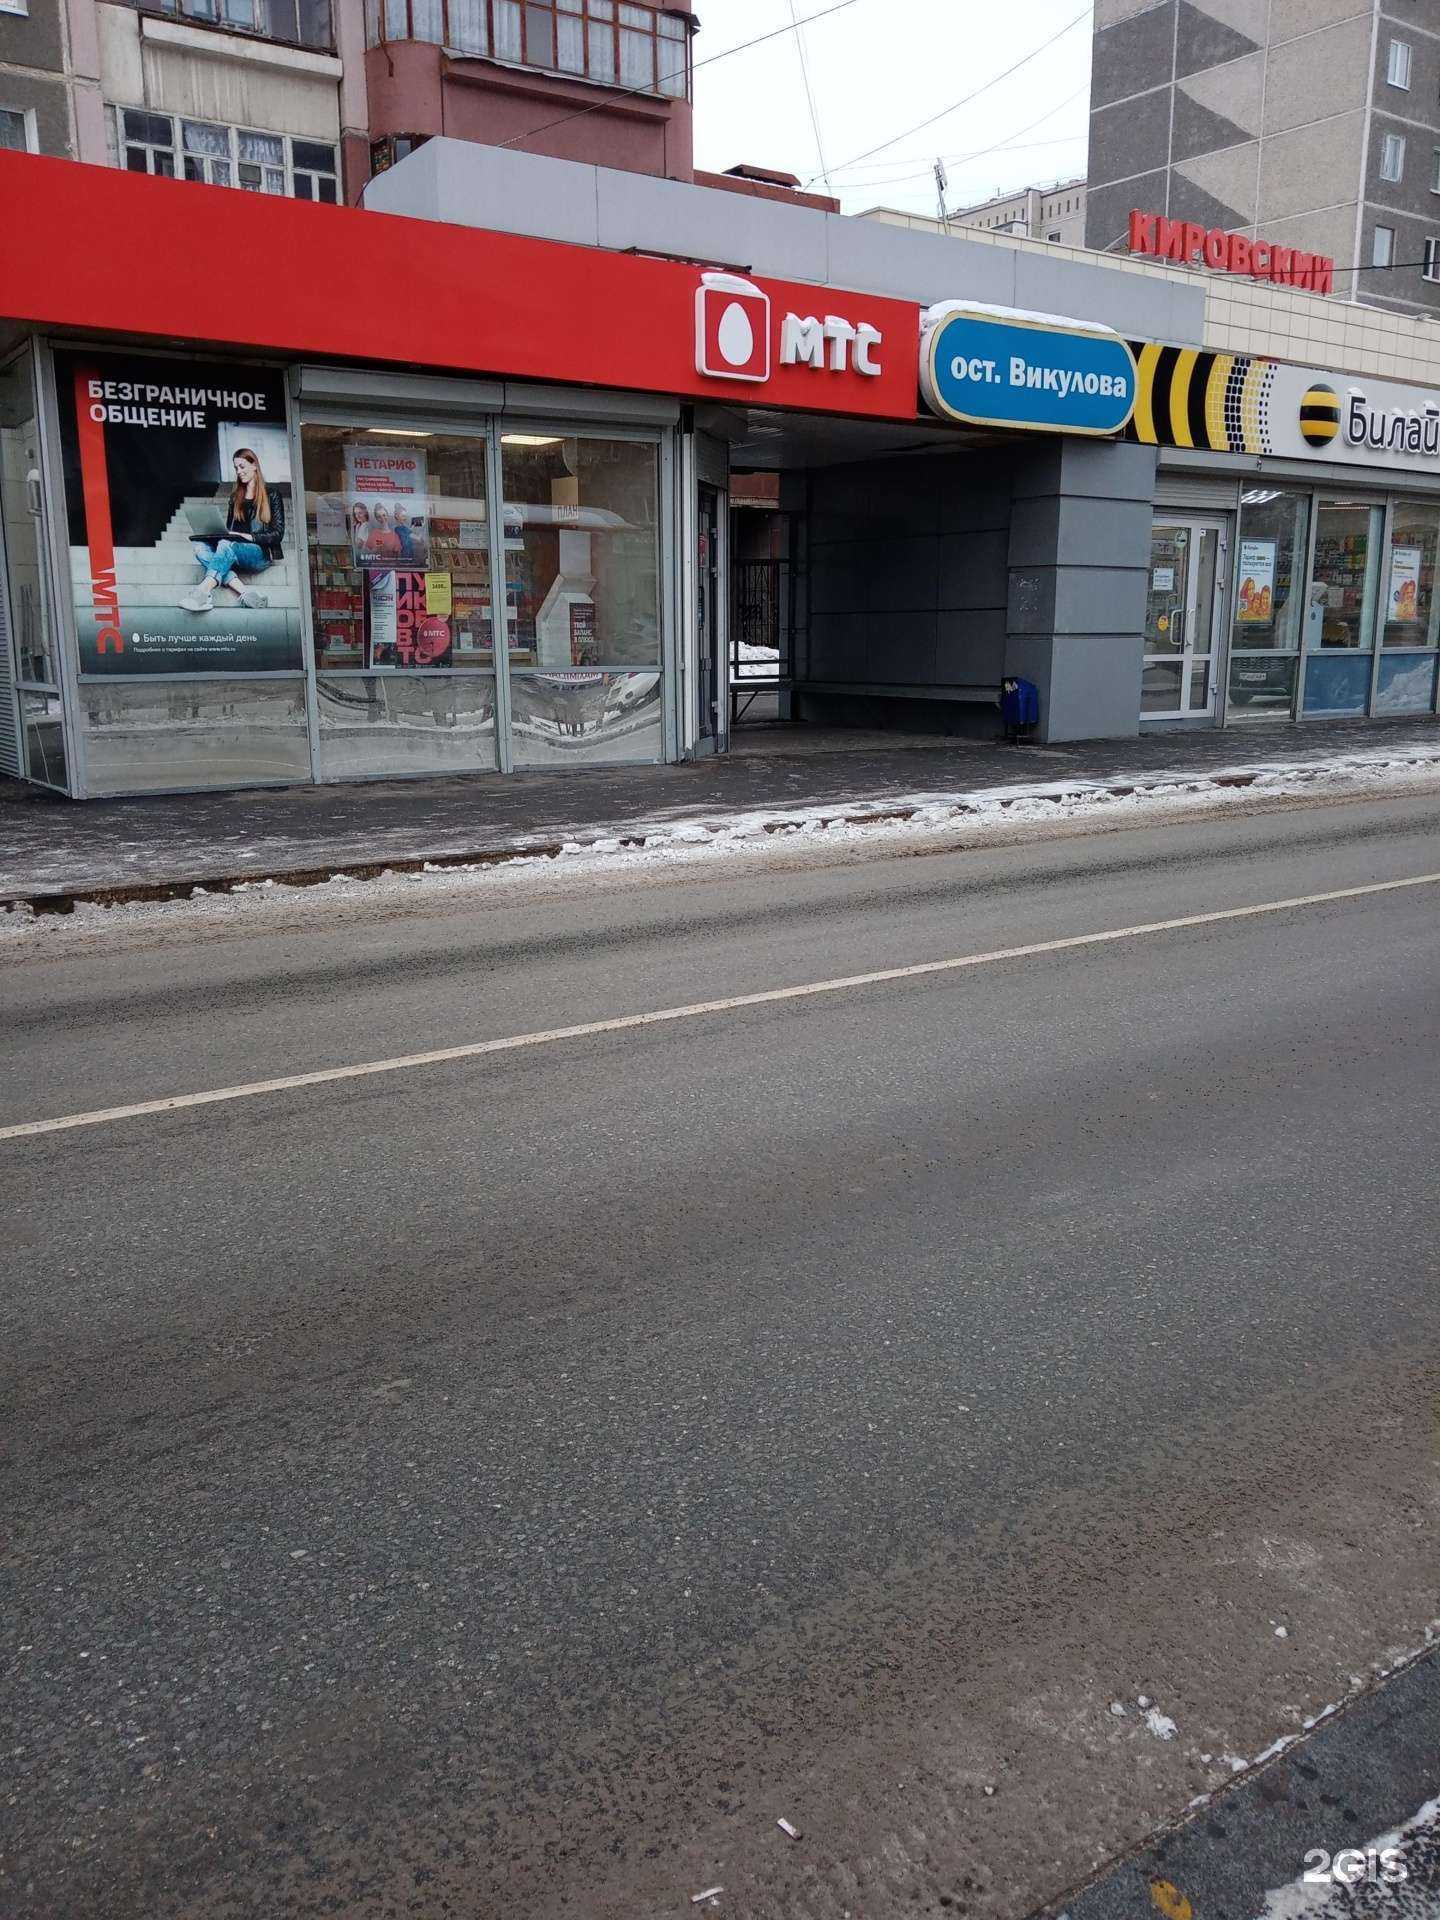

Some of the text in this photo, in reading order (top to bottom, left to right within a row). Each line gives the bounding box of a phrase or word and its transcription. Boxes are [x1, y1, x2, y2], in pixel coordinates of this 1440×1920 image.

[779, 312, 883, 377] МТС
[950, 356, 1127, 398] ост. Викулова
[87, 380, 267, 411] БЕЗГРАНИЧНОЕ
[89, 404, 207, 428] ОБЩЕНИЕ
[354, 457, 417, 471] НЕТАРИФ
[91, 567, 124, 654] МТС
[143, 633, 257, 643] Быть лучше каждый день
